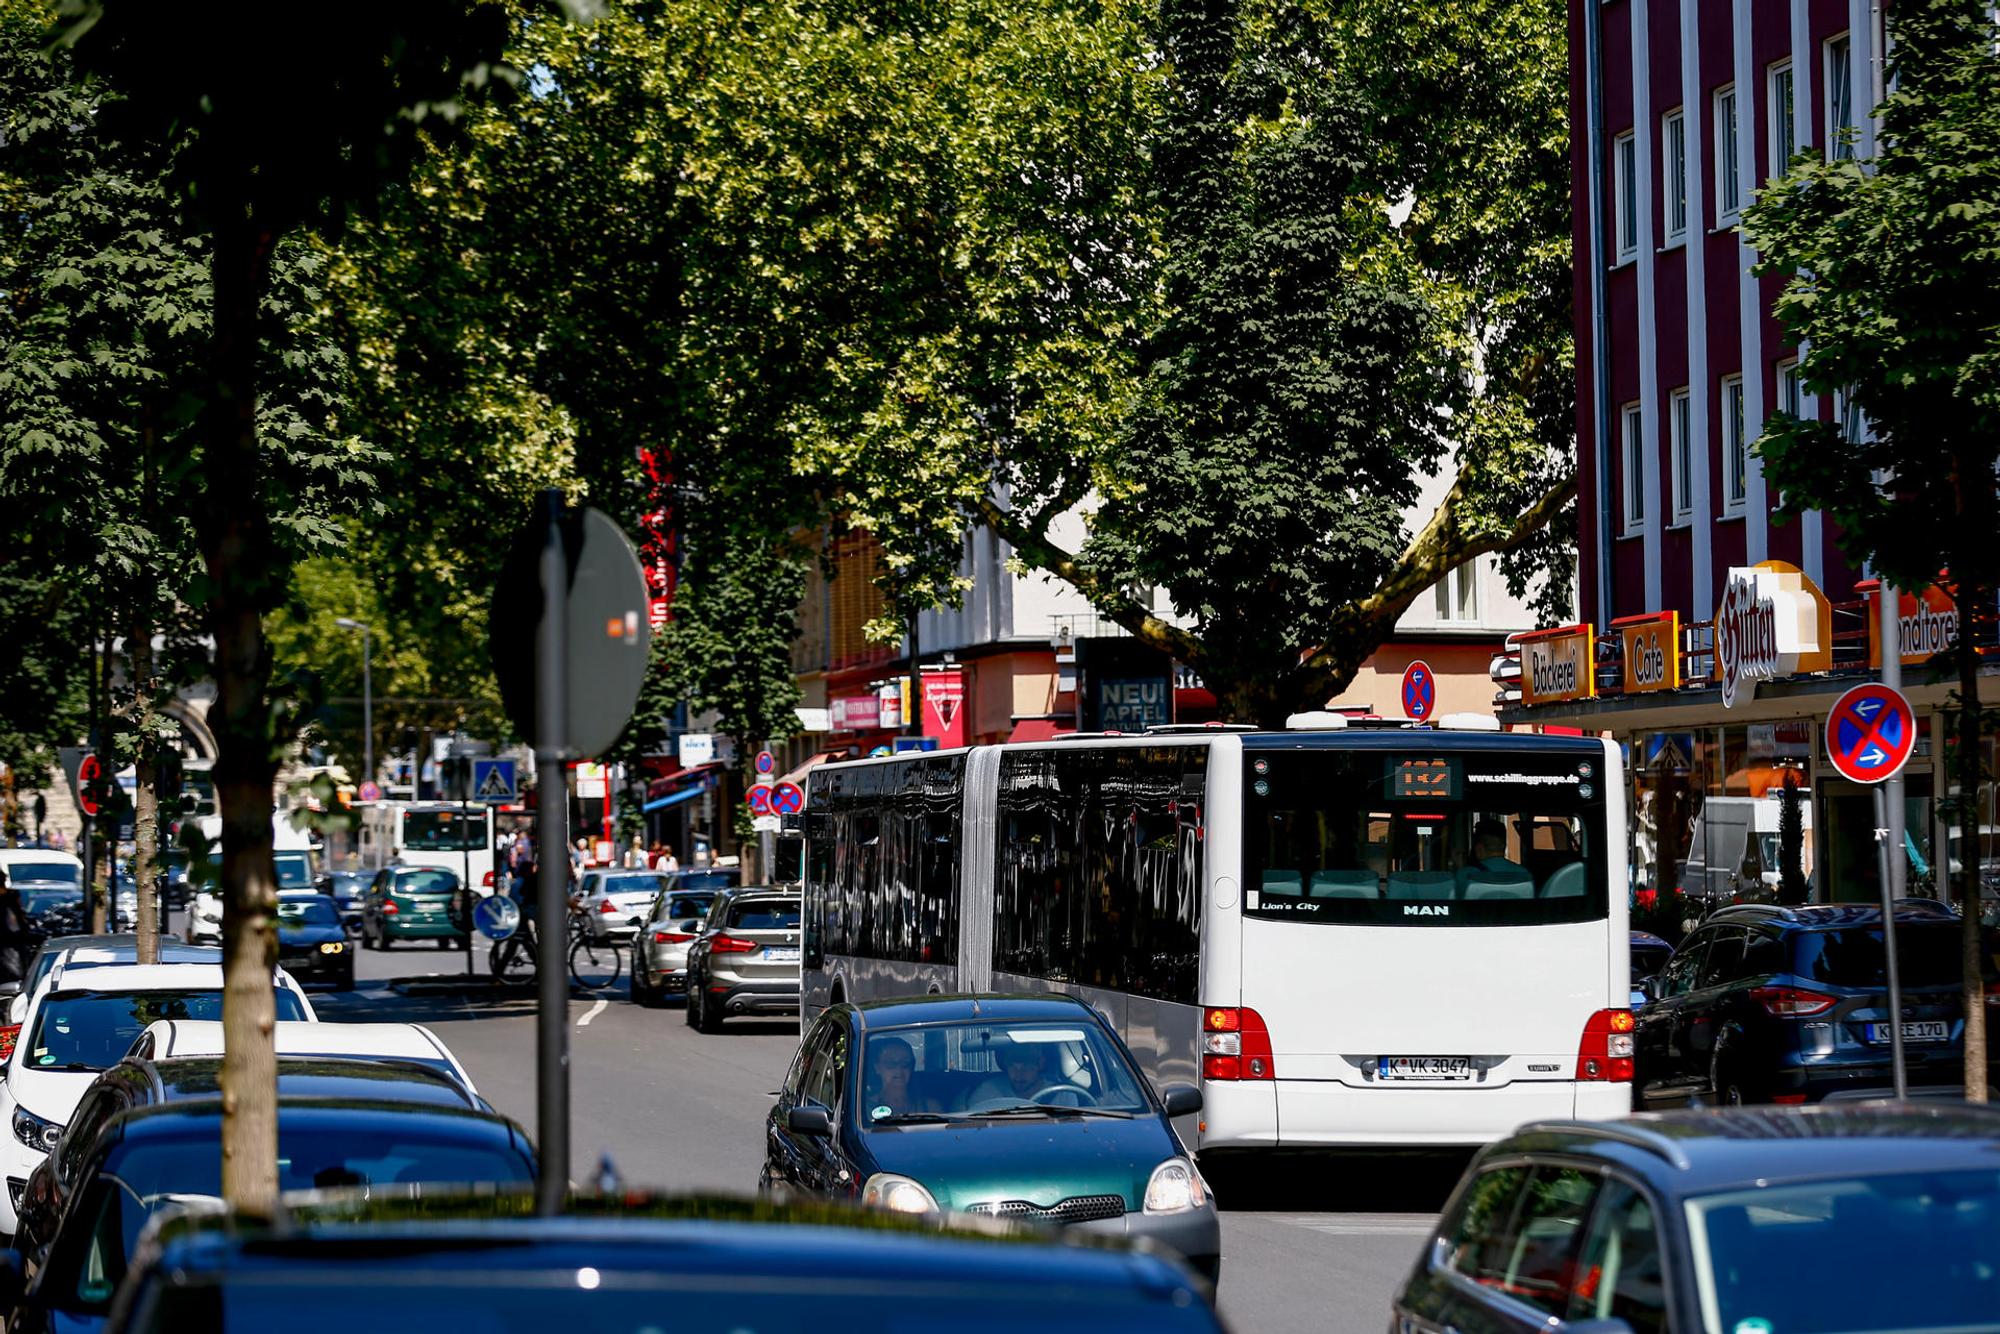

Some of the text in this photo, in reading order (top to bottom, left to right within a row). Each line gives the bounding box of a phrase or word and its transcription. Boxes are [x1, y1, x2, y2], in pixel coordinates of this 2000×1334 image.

[1532, 646, 1577, 696] Bäckerei
[1102, 683, 1165, 705] NEU!
[1103, 705, 1164, 721] APFEL
[1468, 773, 1580, 785] www.schillinggruppe.de
[1261, 902, 1320, 912] Lion's City
[1403, 905, 1449, 916] MAN
[1917, 1023, 1943, 1036] 170
[1390, 1058, 1467, 1074] K VK 3047
